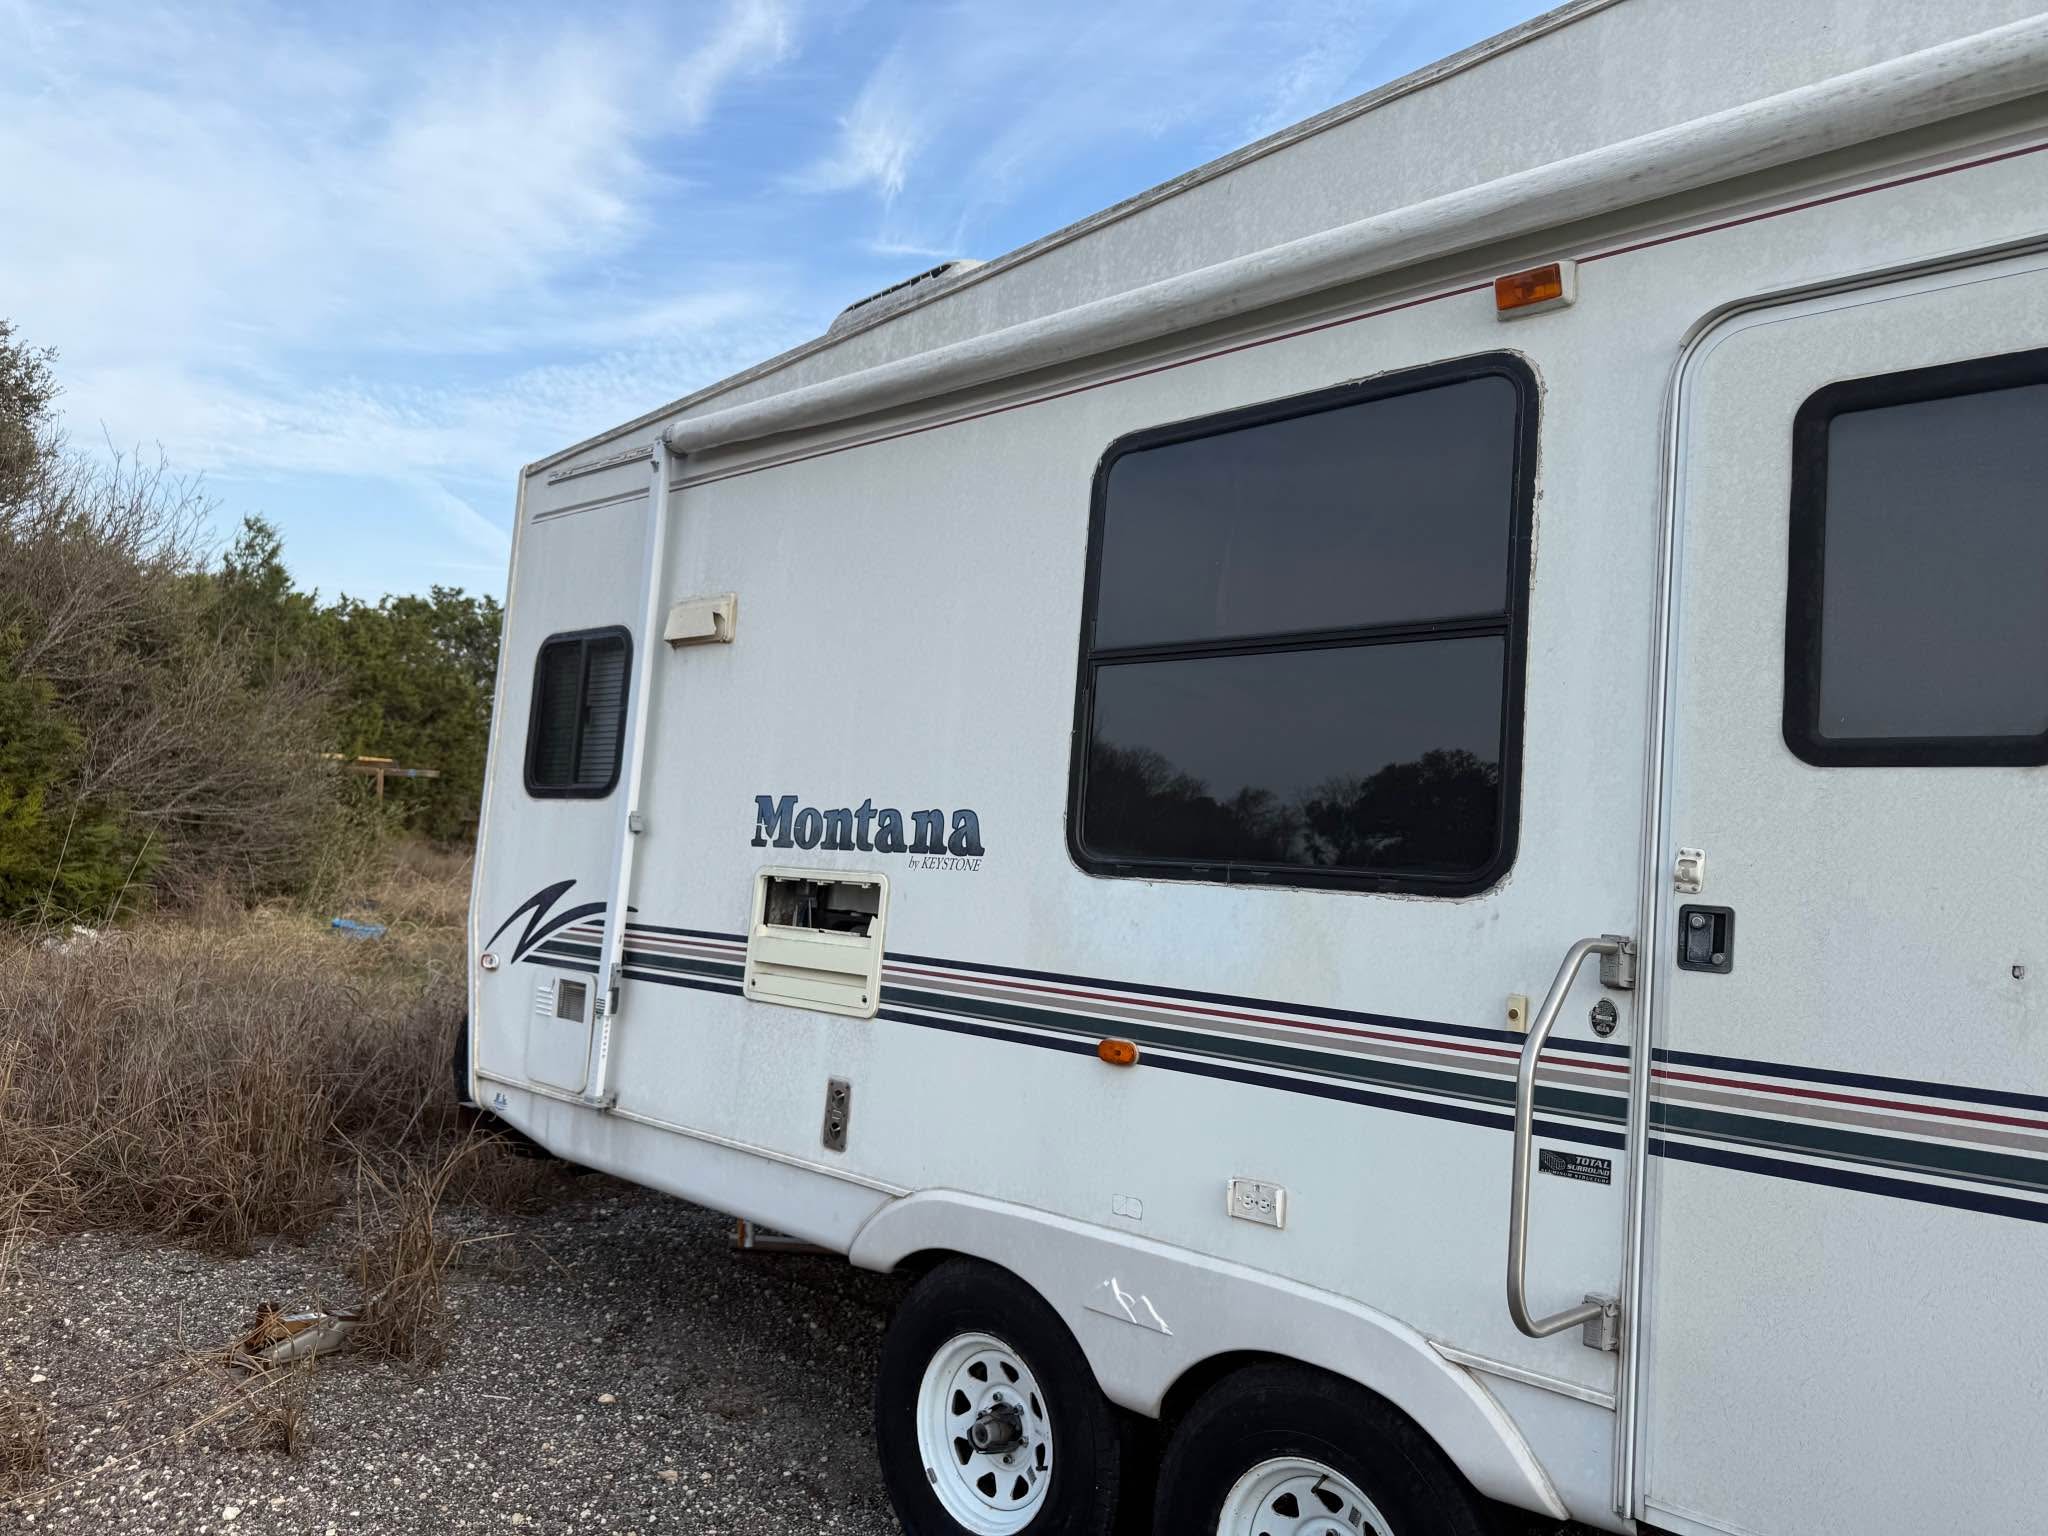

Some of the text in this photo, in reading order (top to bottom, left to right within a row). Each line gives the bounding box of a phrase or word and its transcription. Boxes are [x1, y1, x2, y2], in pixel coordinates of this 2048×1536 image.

[751, 795, 985, 857] Montana
[908, 856, 982, 872] by KEYSTONE
[1576, 1156, 1610, 1169] TOTAL
[1567, 1164, 1610, 1176] SURROUND
